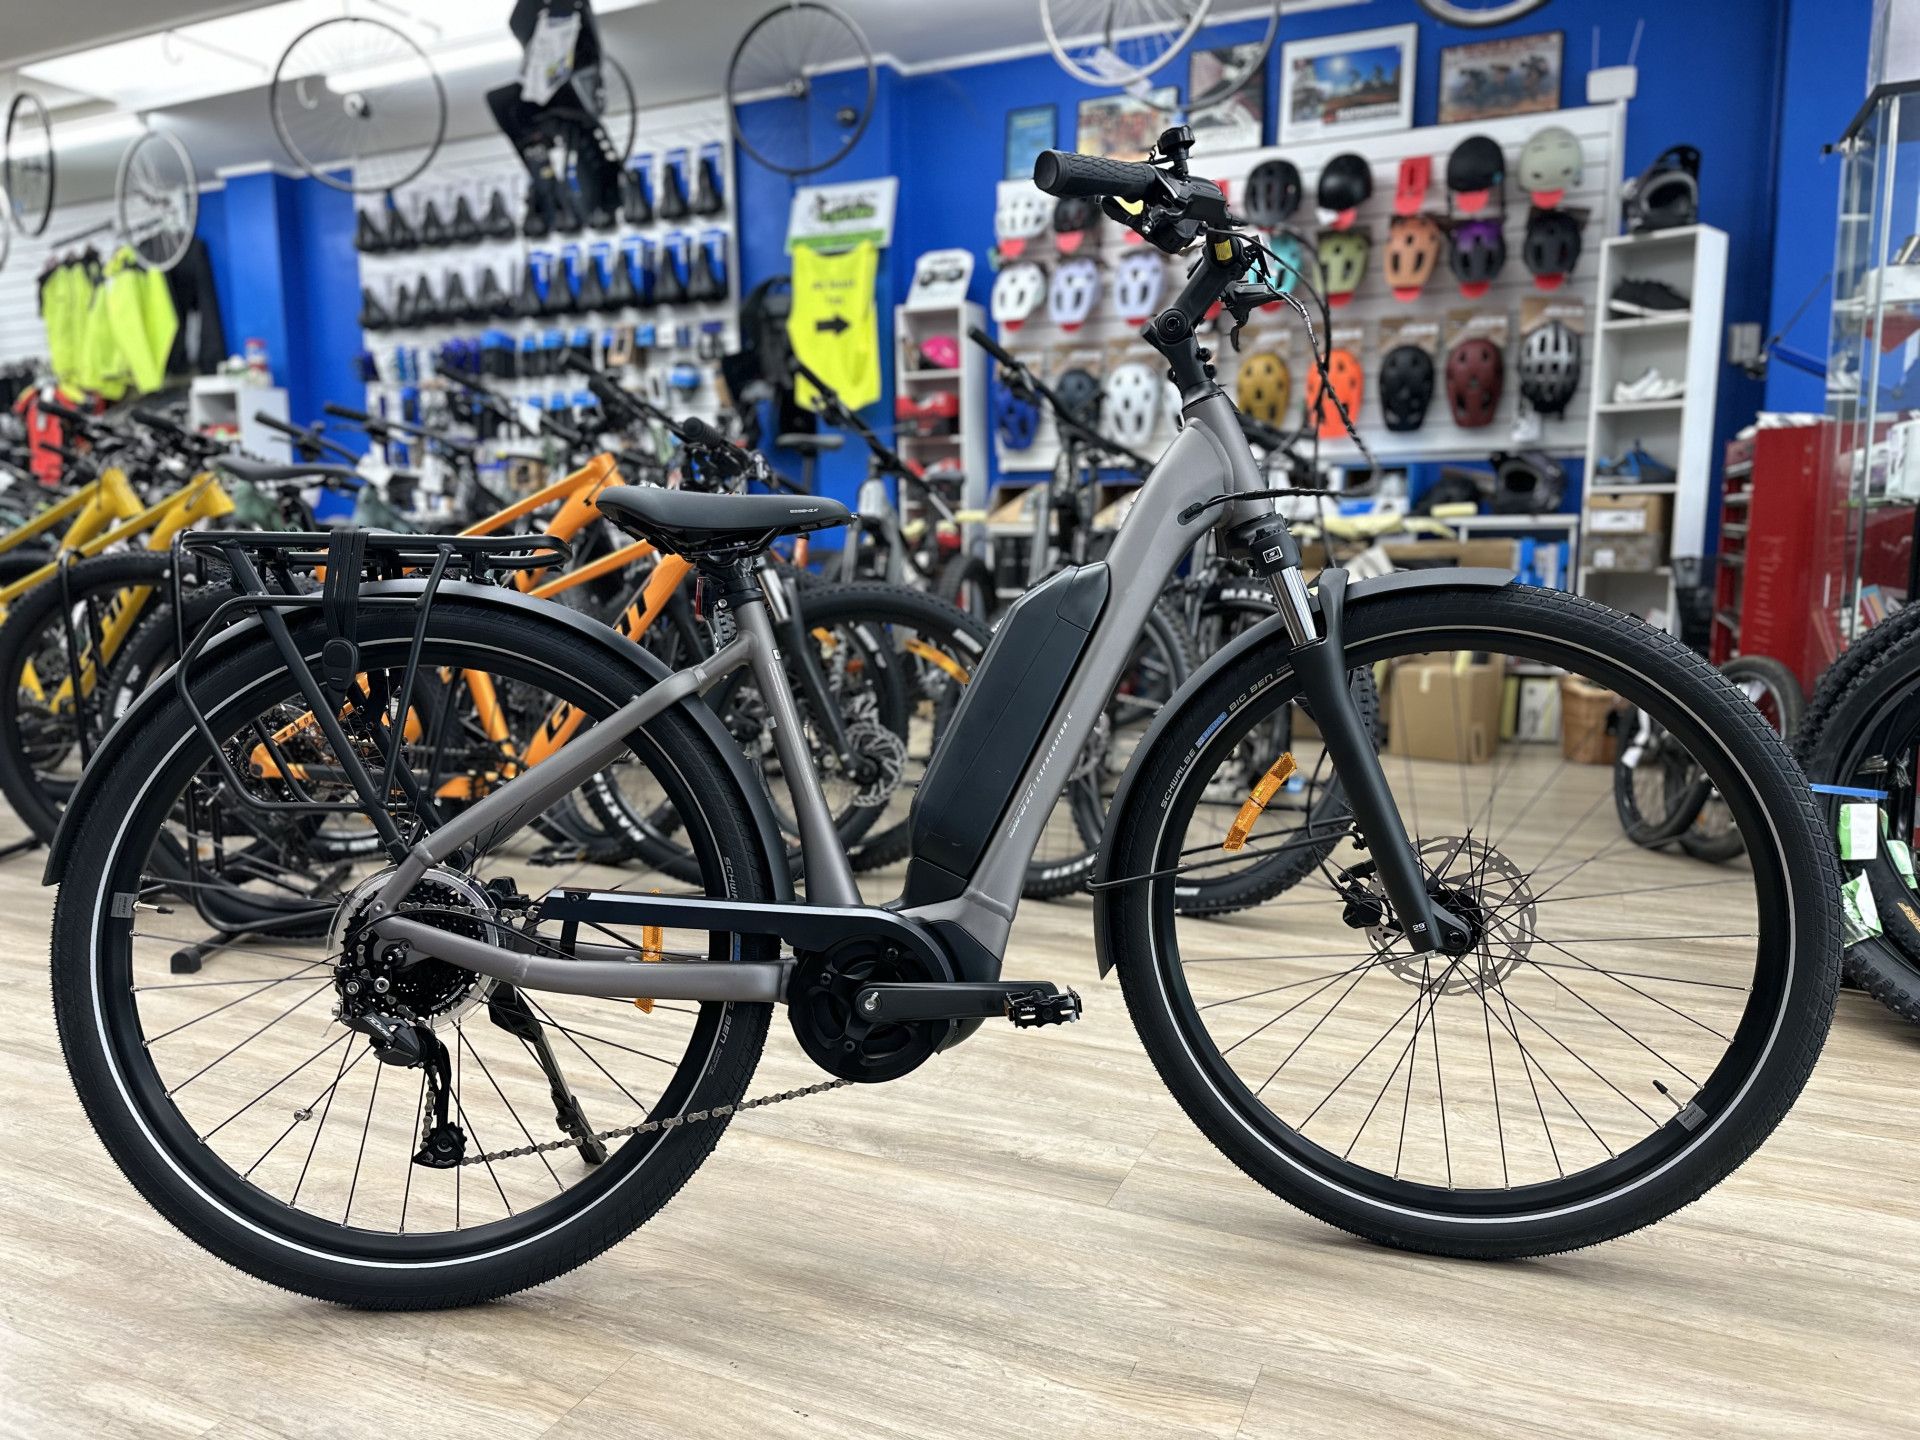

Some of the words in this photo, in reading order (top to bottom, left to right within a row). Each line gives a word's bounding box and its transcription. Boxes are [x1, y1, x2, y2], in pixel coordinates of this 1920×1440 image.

[1160, 748, 1196, 810] SCHWALBE
[1228, 693, 1247, 712] BIG
[1249, 673, 1274, 693] BEN
